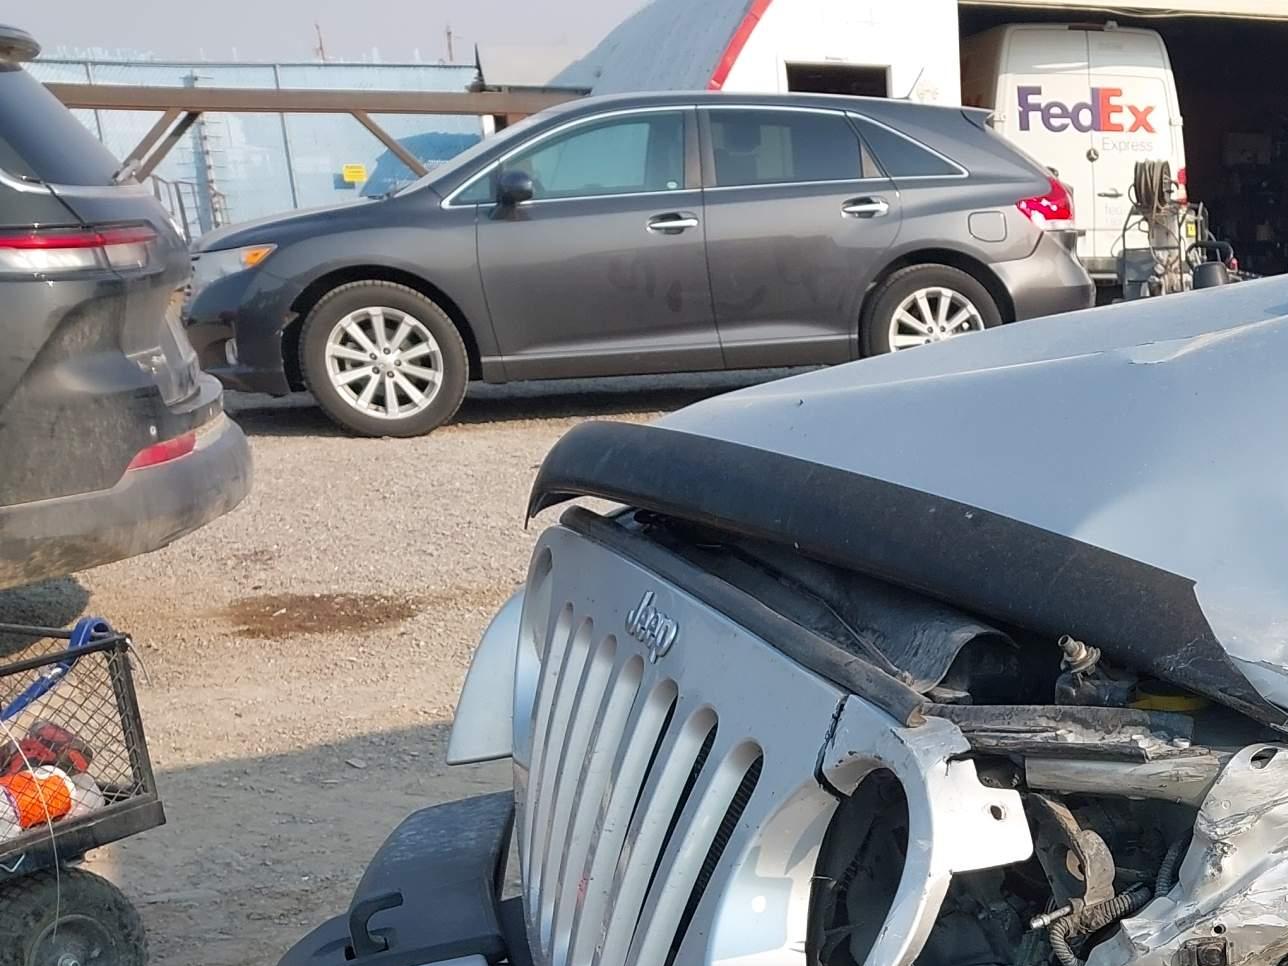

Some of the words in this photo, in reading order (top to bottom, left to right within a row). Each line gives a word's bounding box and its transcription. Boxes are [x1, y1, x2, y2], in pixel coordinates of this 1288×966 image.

[1017, 85, 1158, 133] FedEx
[1101, 137, 1153, 153] Express
[625, 591, 679, 664] Jeep
